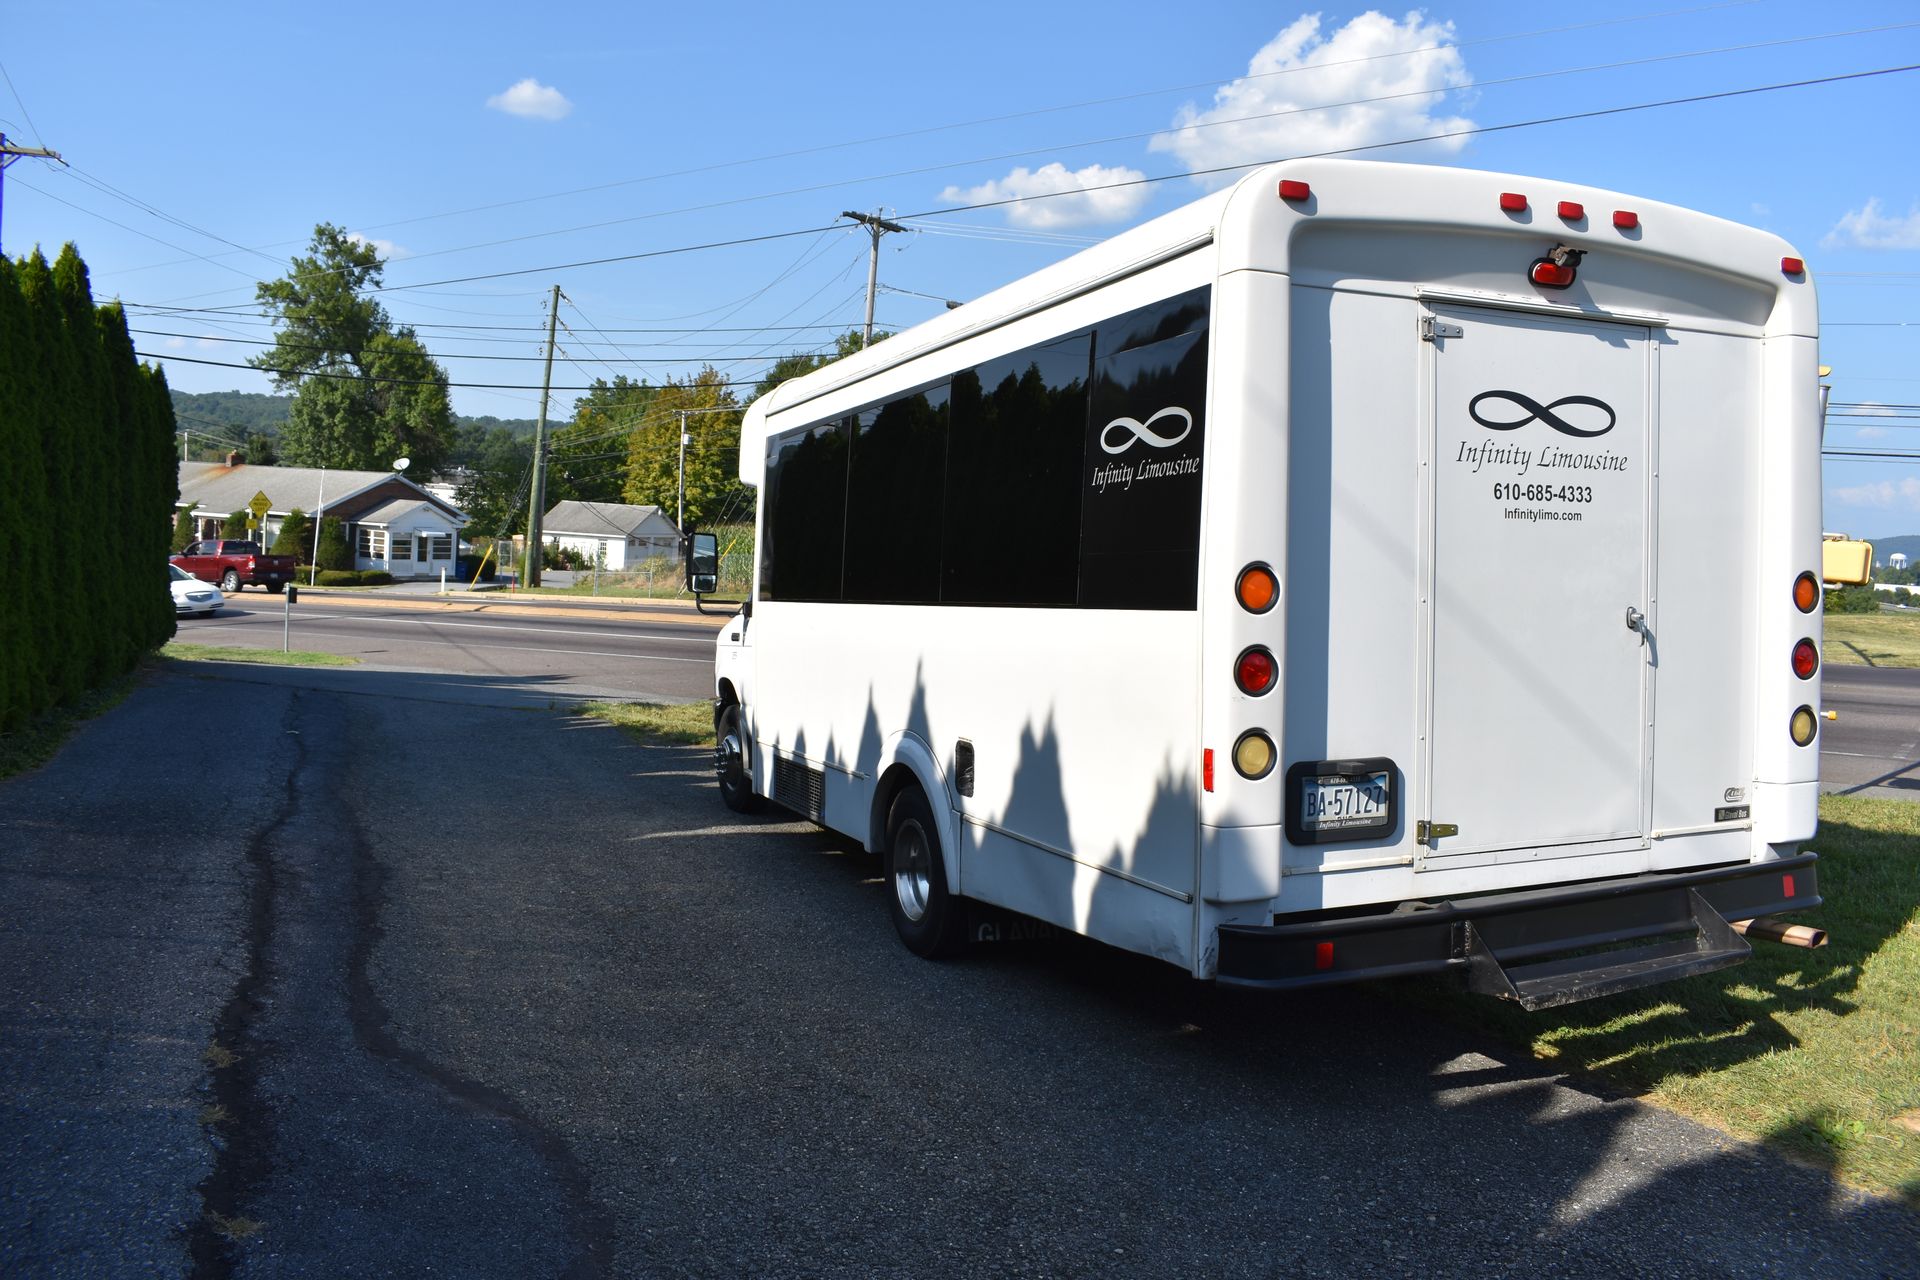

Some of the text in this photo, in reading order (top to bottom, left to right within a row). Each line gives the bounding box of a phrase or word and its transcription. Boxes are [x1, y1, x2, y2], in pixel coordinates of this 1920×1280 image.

[1456, 439, 1628, 476] Infinity Limousine
[1091, 453, 1200, 494] Infinity Limousine
[1493, 482, 1593, 503] 610-685-4333
[1504, 508, 1582, 523] Infinitylimo.com
[1307, 786, 1383, 817] BA-57127
[1319, 819, 1372, 830] Infinity Limousine
